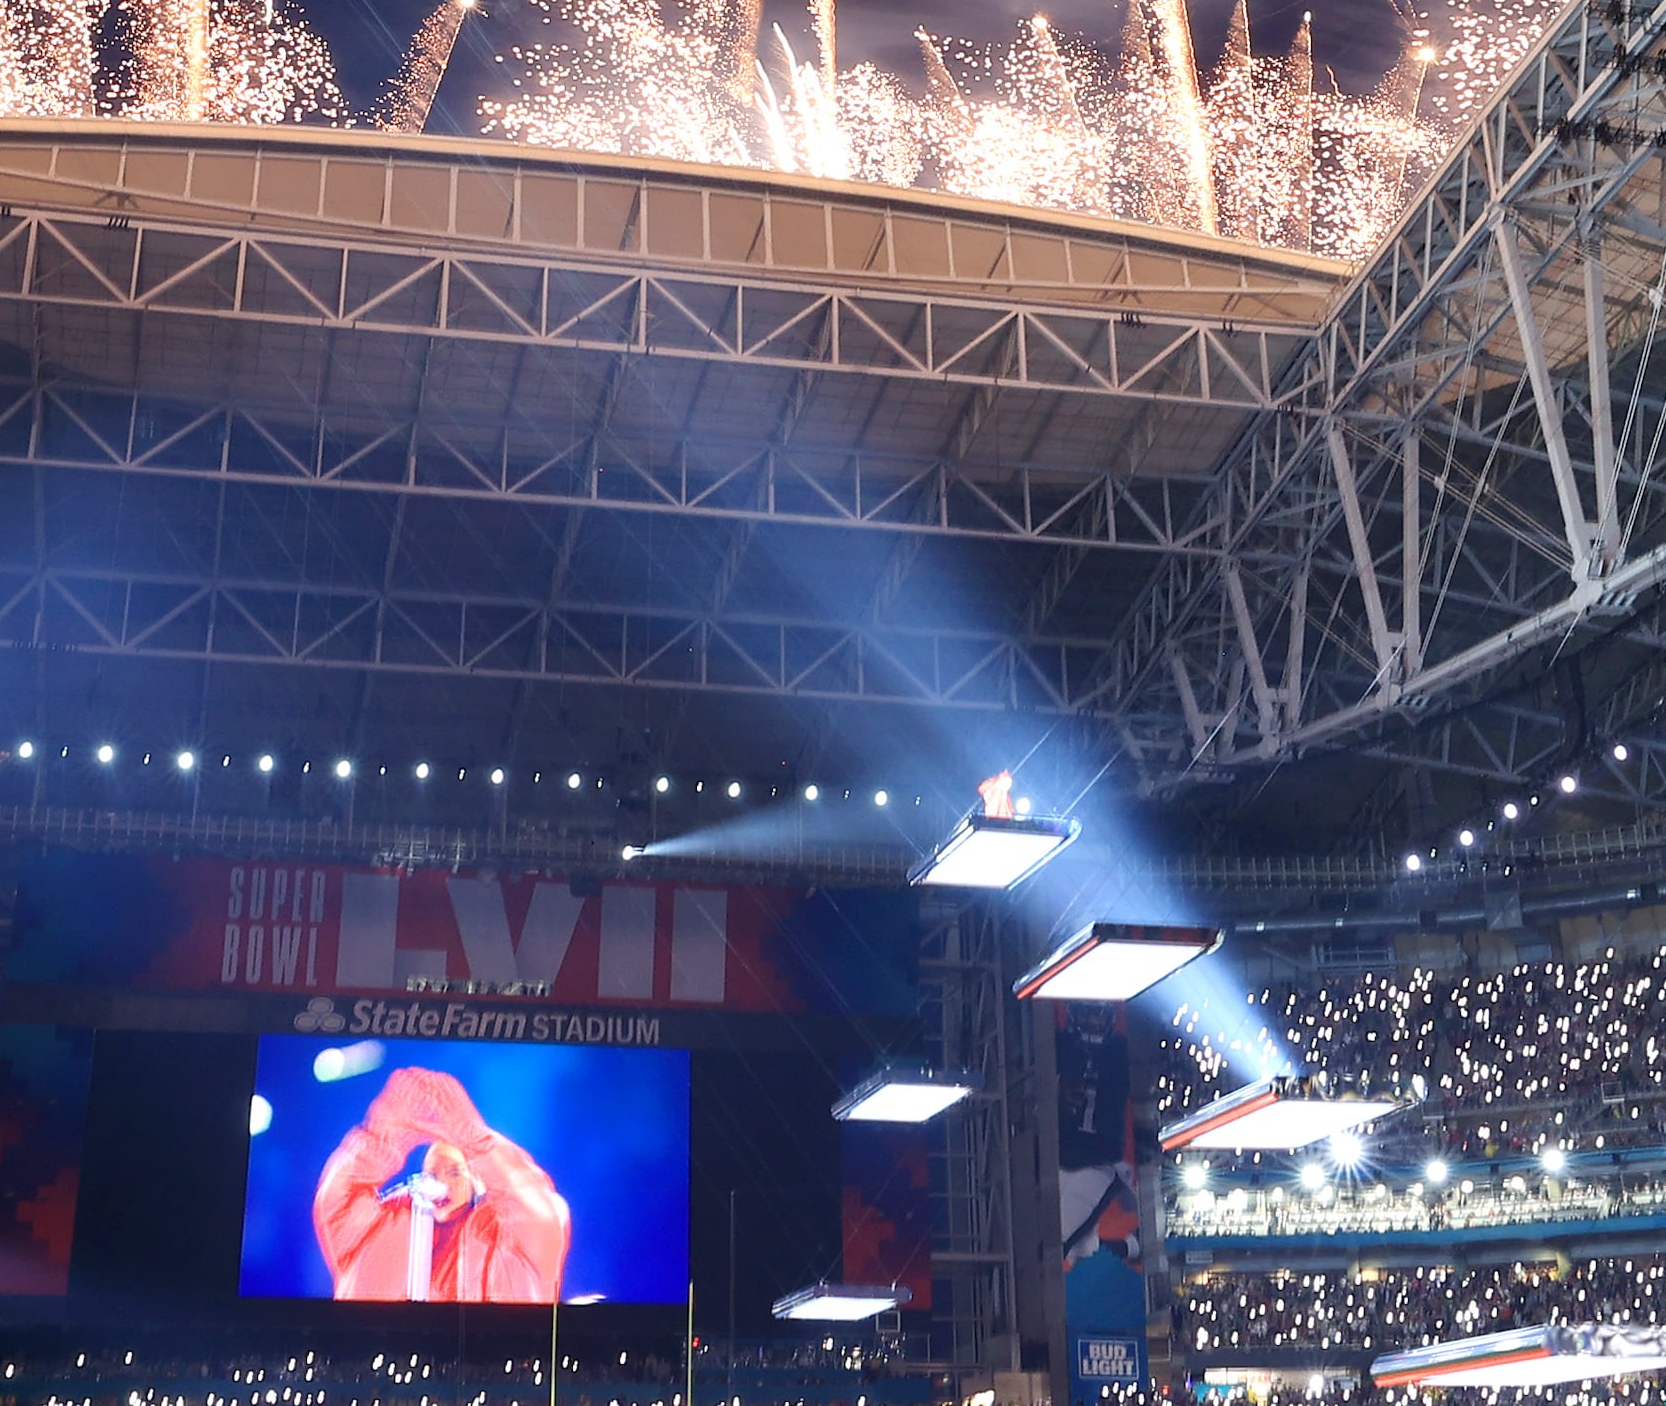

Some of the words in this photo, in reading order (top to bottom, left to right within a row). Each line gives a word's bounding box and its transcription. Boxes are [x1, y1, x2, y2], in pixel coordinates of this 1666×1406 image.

[229, 866, 326, 924] SUPER
[221, 923, 319, 987] BOWL
[335, 870, 728, 1003] LVII
[530, 1012, 661, 1045] STADIUM
[1083, 1358, 1134, 1376] LIGHT
[1089, 1343, 1126, 1360] BUD
